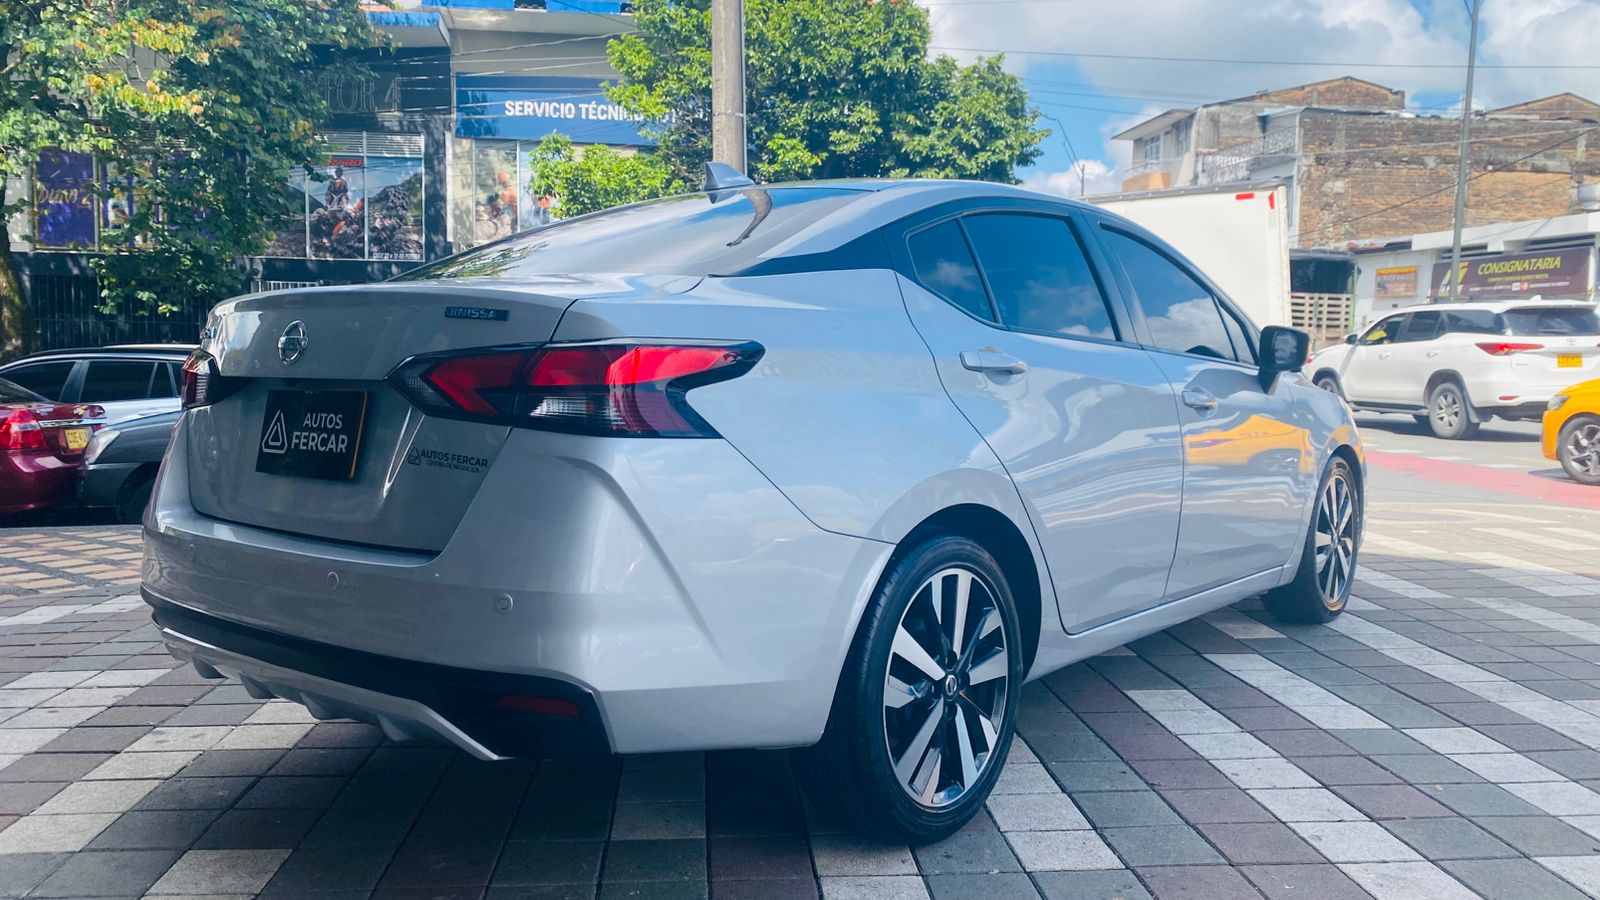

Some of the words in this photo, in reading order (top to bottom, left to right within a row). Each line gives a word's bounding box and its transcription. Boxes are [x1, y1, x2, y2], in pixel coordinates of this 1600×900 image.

[504, 100, 576, 119] SERVICIO
[1477, 256, 1561, 275] CONSIGNATARIA
[303, 413, 343, 429] AUTOS
[291, 432, 348, 453] FERCAR
[421, 449, 449, 461] AUTOS
[451, 454, 488, 468] FERCAR
